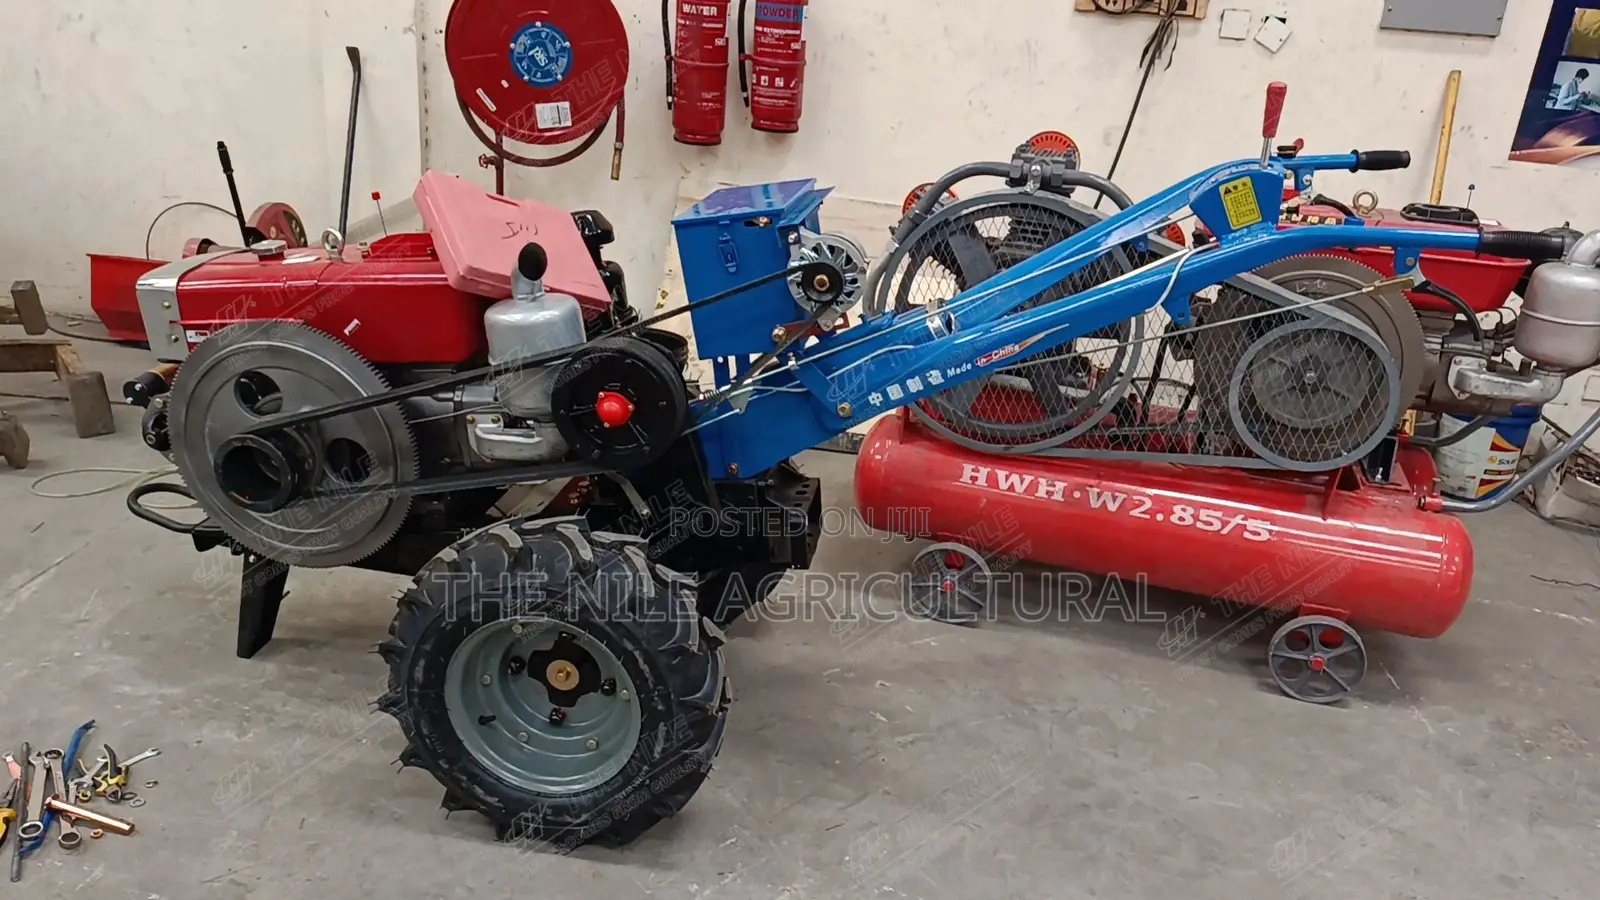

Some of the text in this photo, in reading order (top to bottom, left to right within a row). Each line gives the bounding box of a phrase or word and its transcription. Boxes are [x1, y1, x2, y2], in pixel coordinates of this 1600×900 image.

[682, 3, 718, 16] WATER
[946, 342, 1020, 378] Made in China
